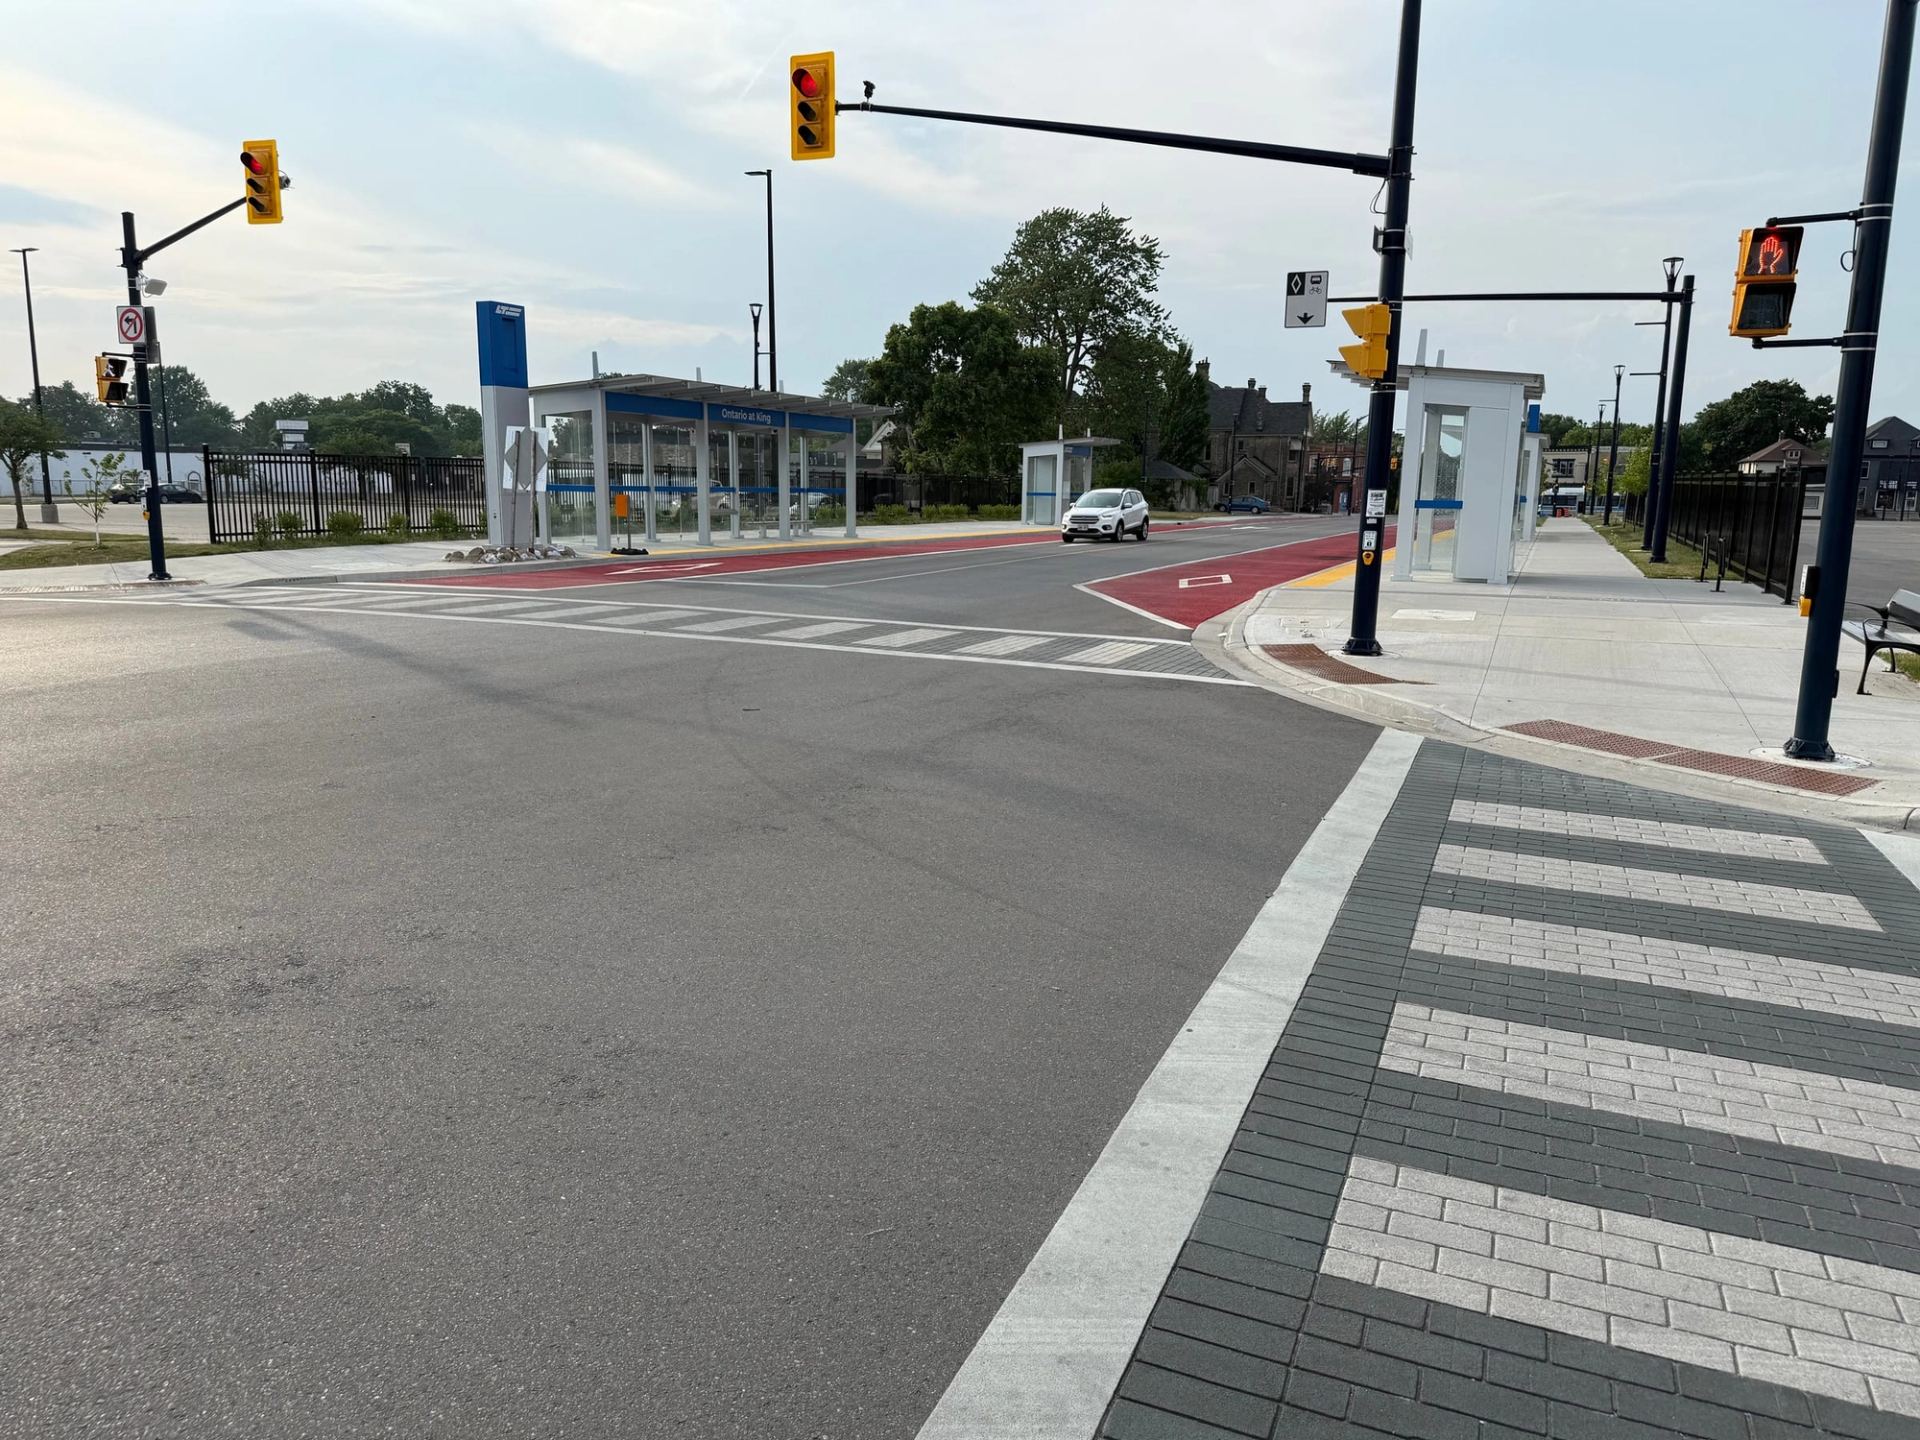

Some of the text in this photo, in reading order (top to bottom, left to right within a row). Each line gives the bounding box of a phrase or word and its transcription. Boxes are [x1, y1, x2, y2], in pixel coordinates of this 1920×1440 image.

[721, 408, 771, 424] Ontario at King
